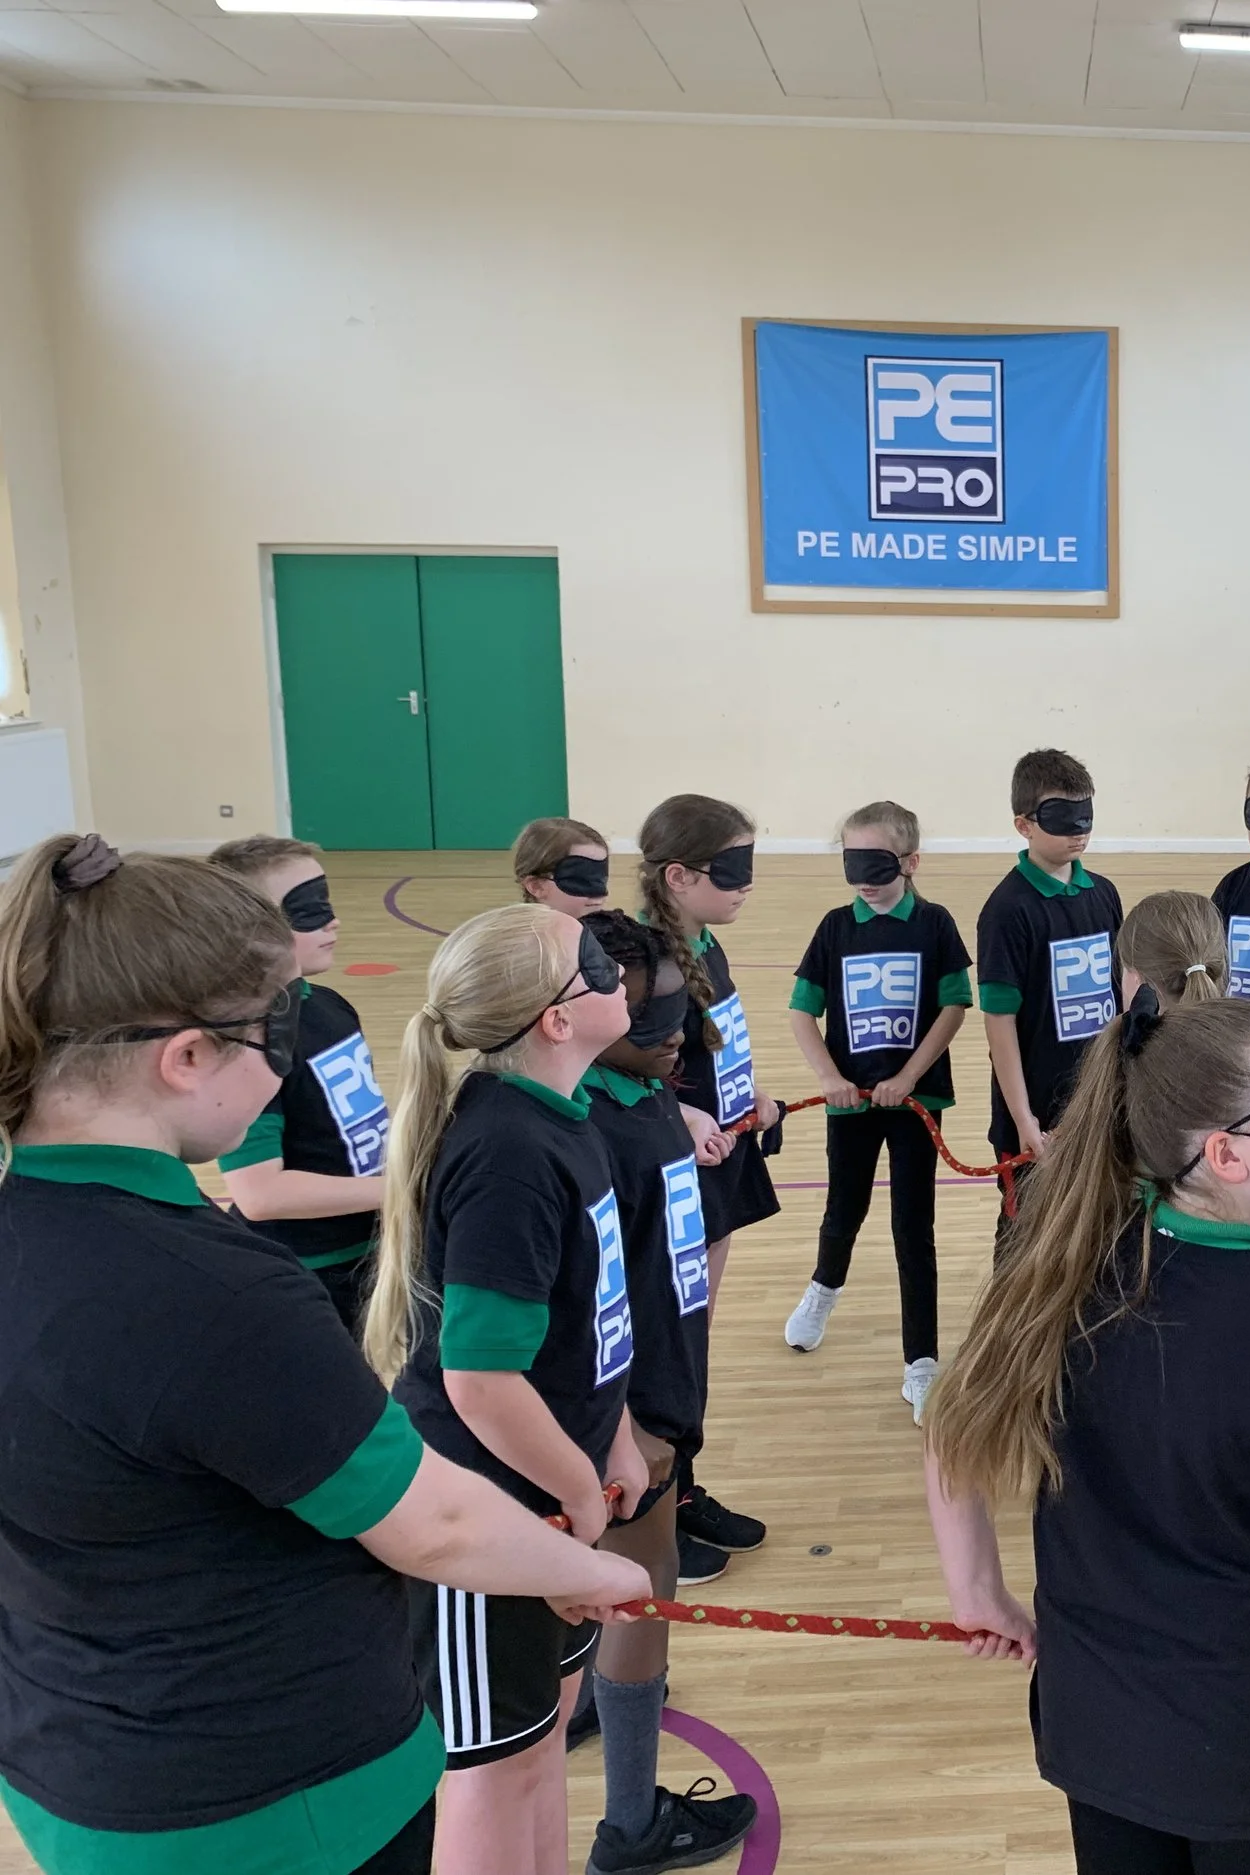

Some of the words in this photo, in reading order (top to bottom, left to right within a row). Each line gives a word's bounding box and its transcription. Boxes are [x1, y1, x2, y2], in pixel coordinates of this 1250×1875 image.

[877, 371, 992, 443] PE
[879, 466, 994, 507] PRO
[797, 531, 840, 558] PE
[851, 533, 947, 561] MADE
[957, 535, 1078, 563] SIMPLE
[847, 961, 915, 1005] PE
[1056, 941, 1110, 992] PE
[852, 1016, 911, 1044] PRO
[1061, 998, 1114, 1031] PRO
[721, 1073, 755, 1113] PR
